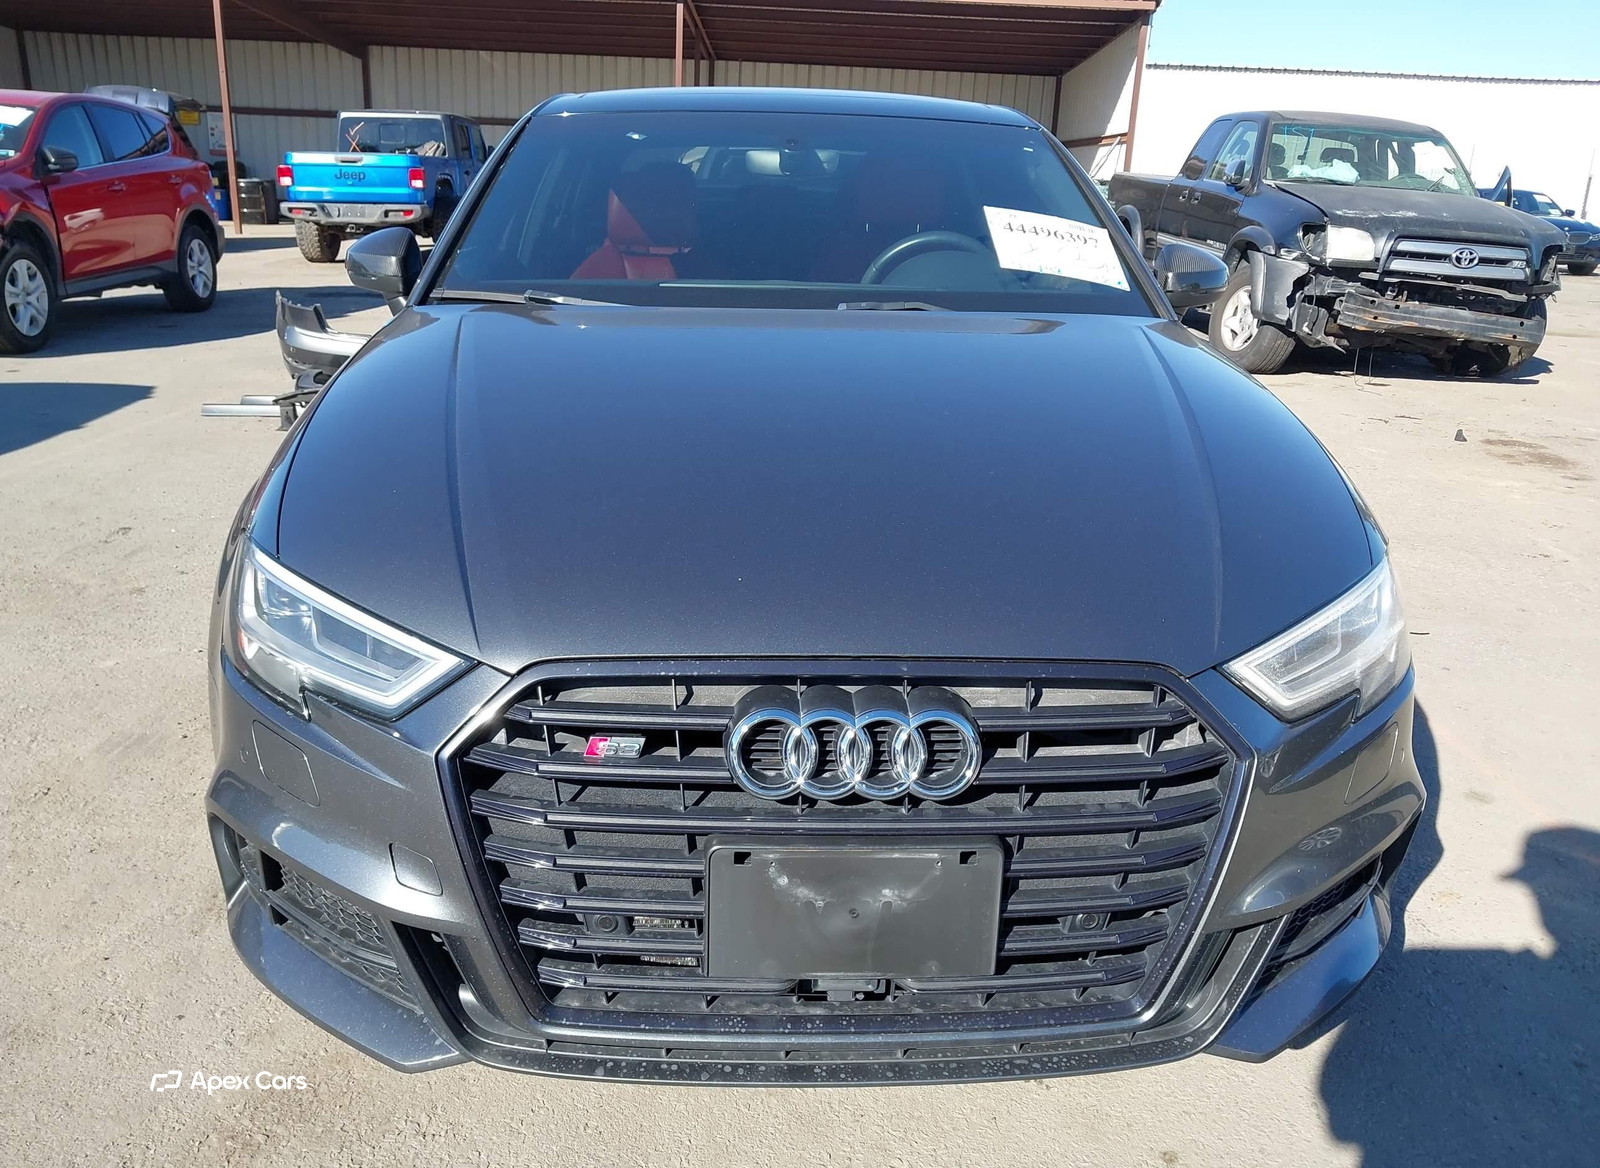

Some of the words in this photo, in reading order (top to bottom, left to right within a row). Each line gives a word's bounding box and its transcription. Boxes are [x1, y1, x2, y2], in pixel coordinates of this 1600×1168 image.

[334, 168, 367, 182] Jeep
[1003, 222, 1099, 248] 44496397
[596, 741, 641, 757] S3
